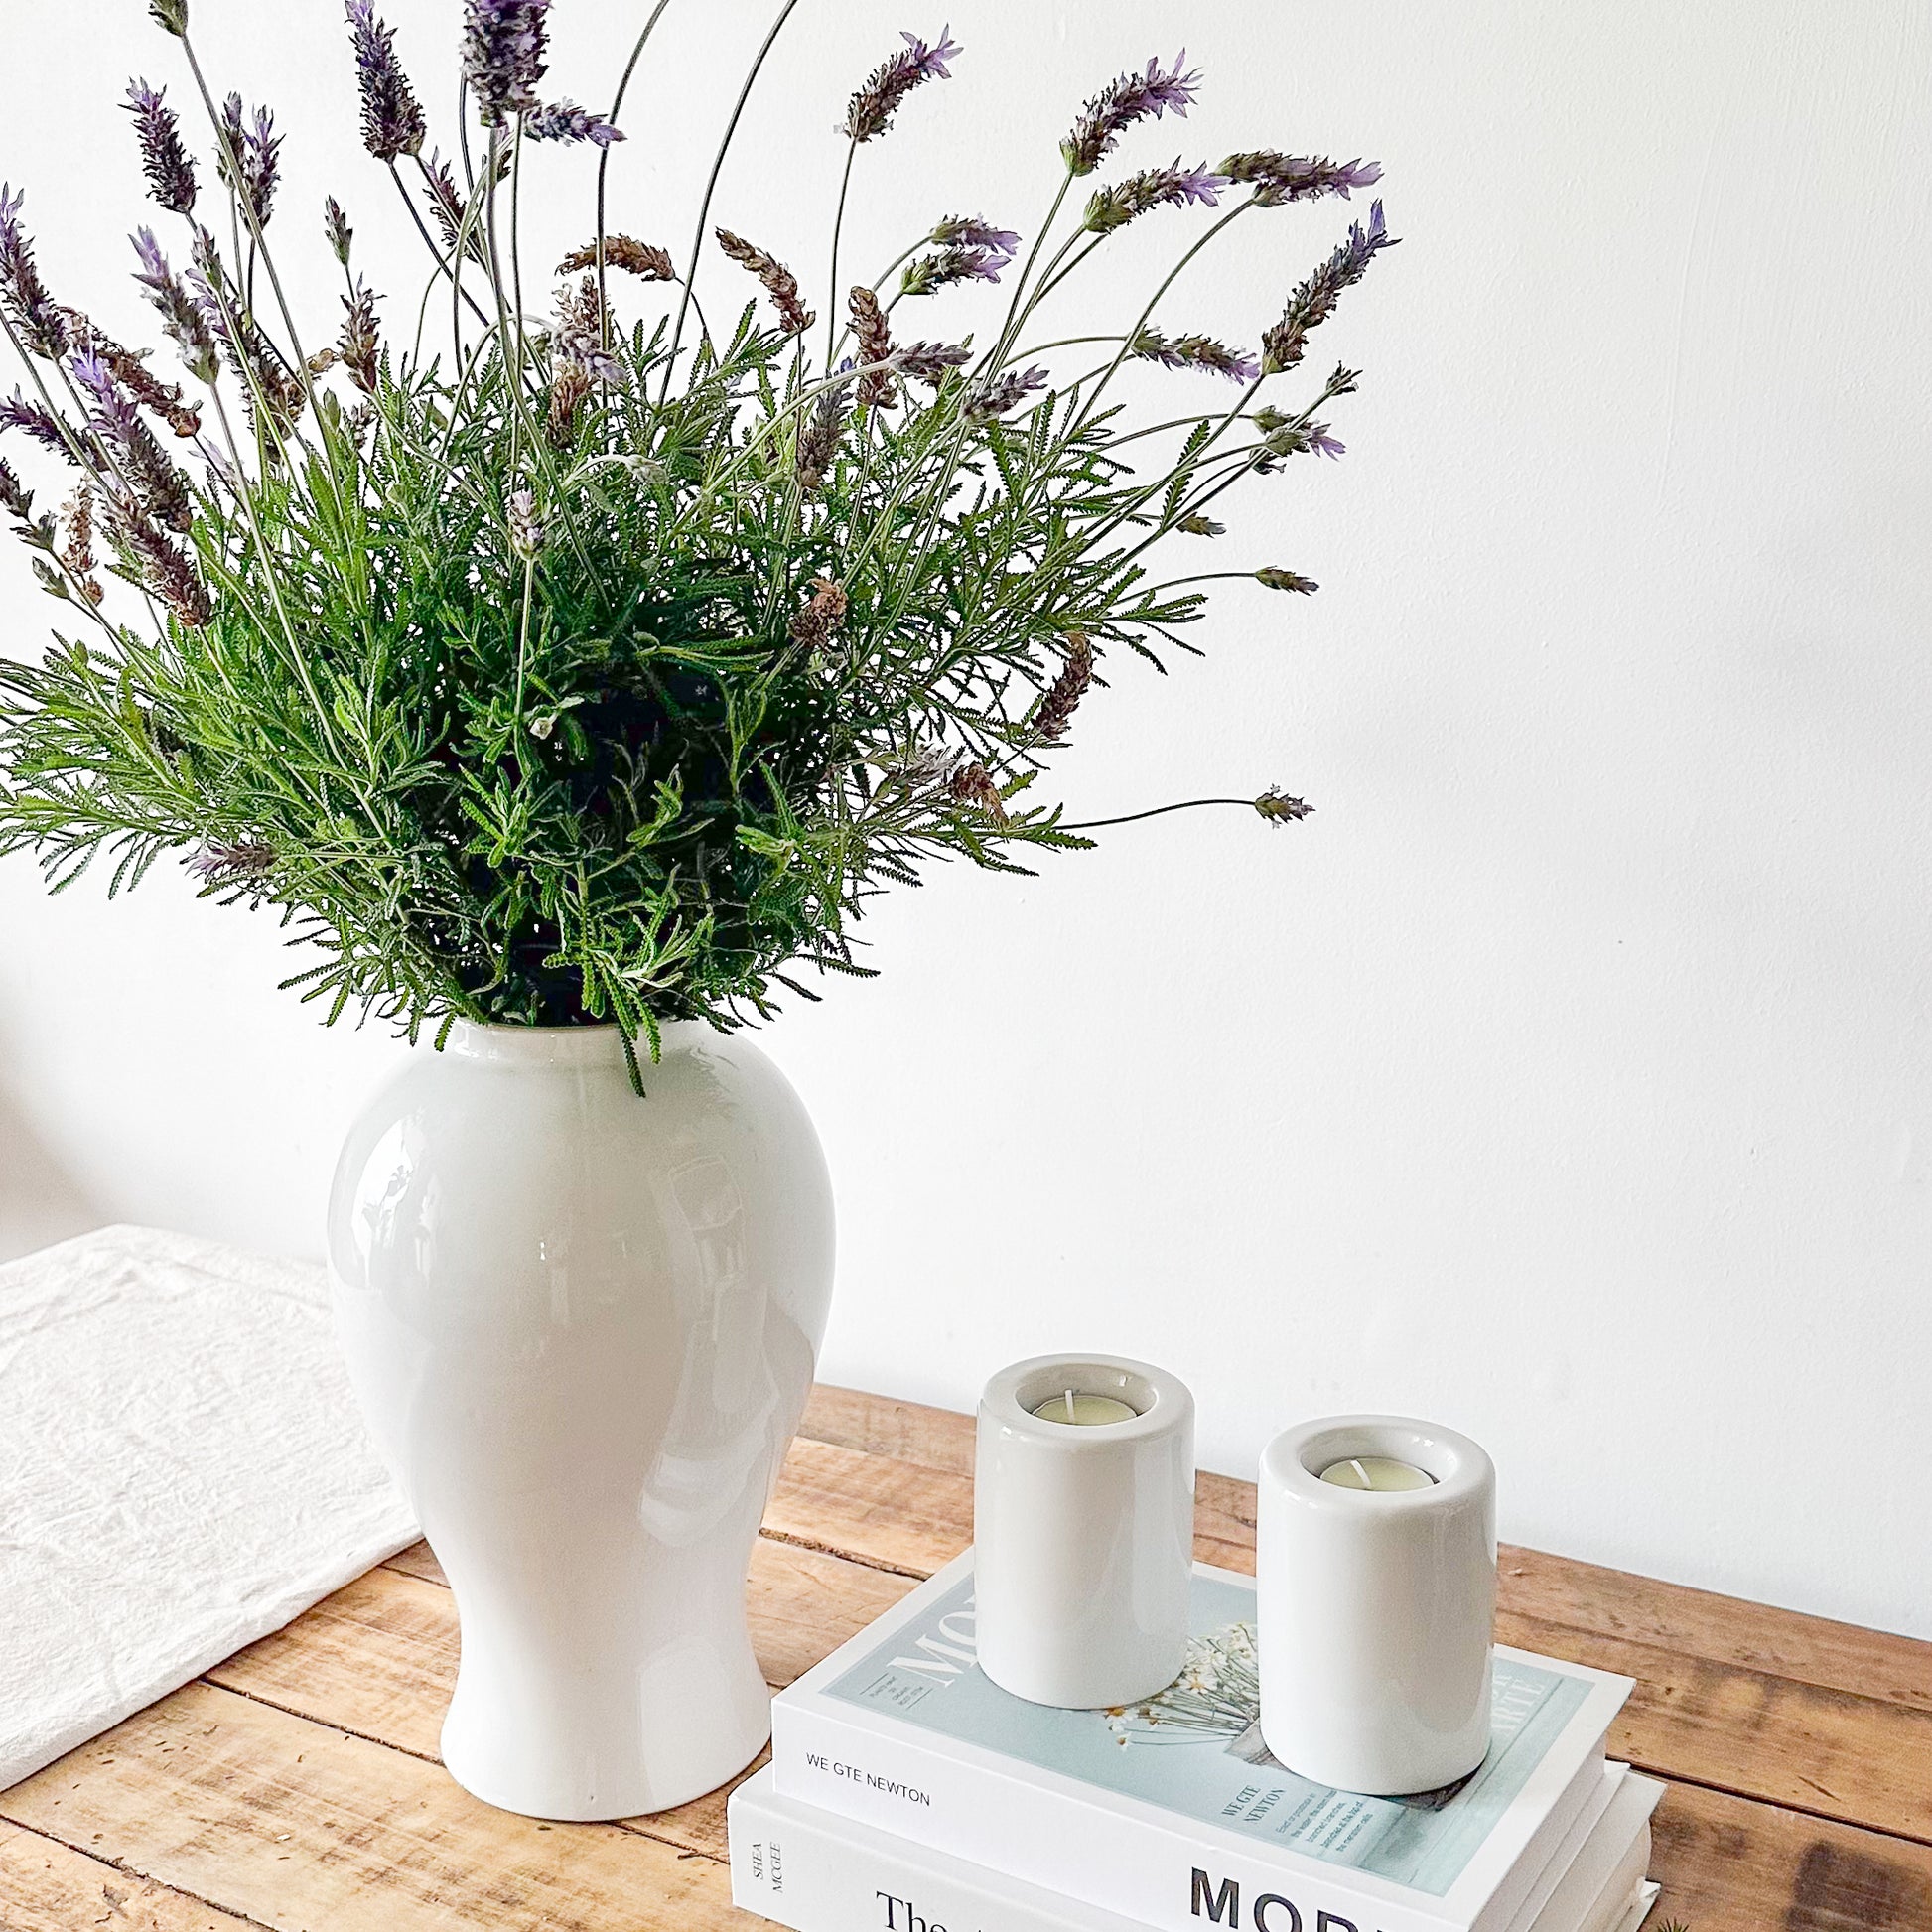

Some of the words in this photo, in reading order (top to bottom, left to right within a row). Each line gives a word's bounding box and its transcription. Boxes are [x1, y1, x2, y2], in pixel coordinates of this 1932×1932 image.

[886, 1594, 977, 1688] MO
[806, 1752, 829, 1771] WE
[833, 1762, 862, 1783] GTE
[867, 1773, 930, 1807] NEWTON
[1221, 1802, 1244, 1816] WE
[1236, 1785, 1261, 1803] GTE
[1242, 1789, 1285, 1822] NEWTON
[752, 1843, 763, 1881] SHEA
[770, 1841, 783, 1893] MCGEE
